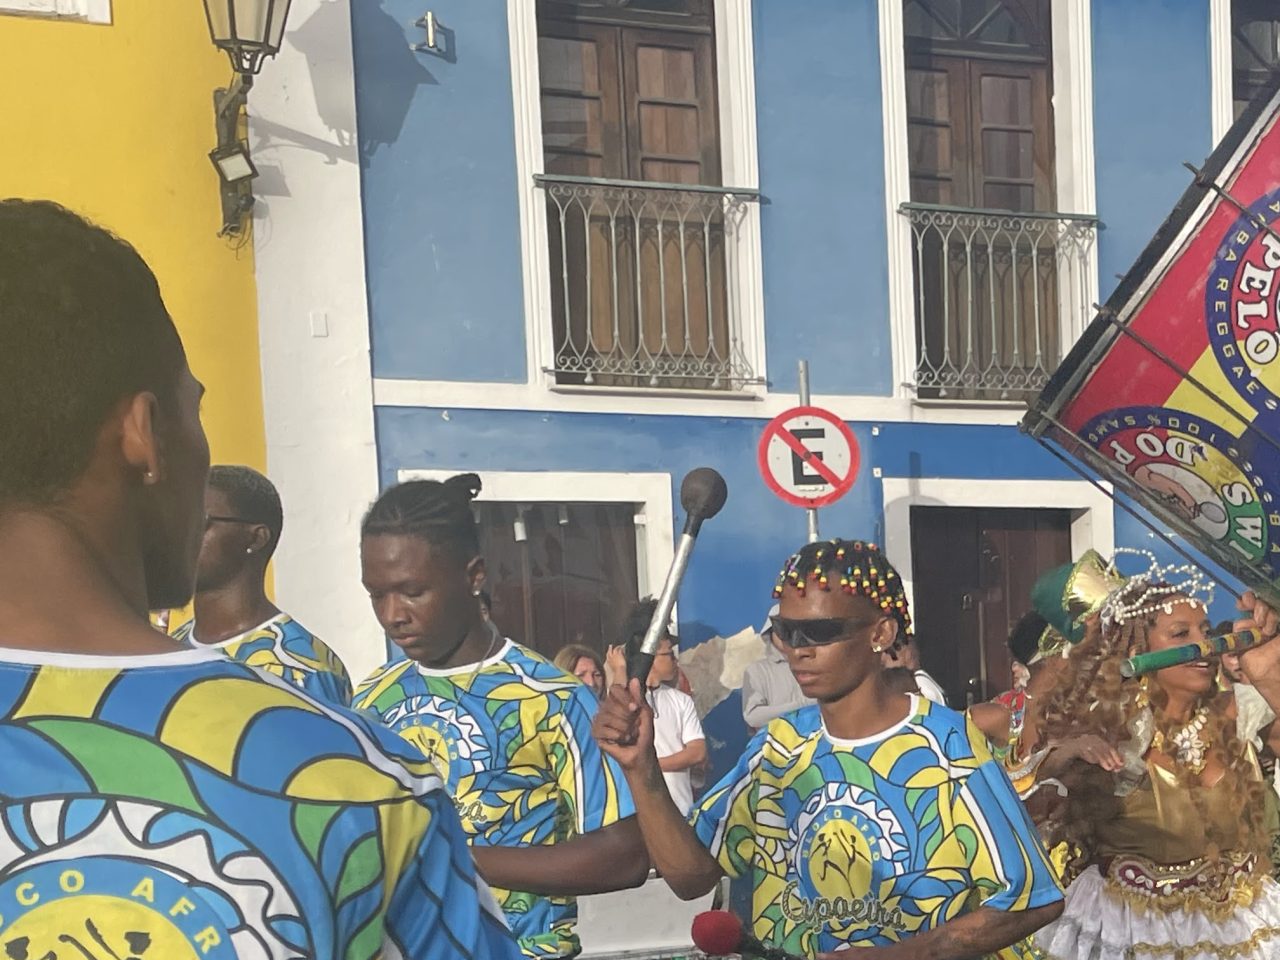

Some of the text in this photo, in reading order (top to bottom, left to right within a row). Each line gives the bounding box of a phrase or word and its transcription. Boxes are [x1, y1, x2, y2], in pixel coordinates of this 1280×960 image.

[1215, 278, 1261, 395] REGGAE
[789, 428, 829, 485] E
[1136, 432, 1196, 467] DO
[851, 815, 880, 862] AFRO
